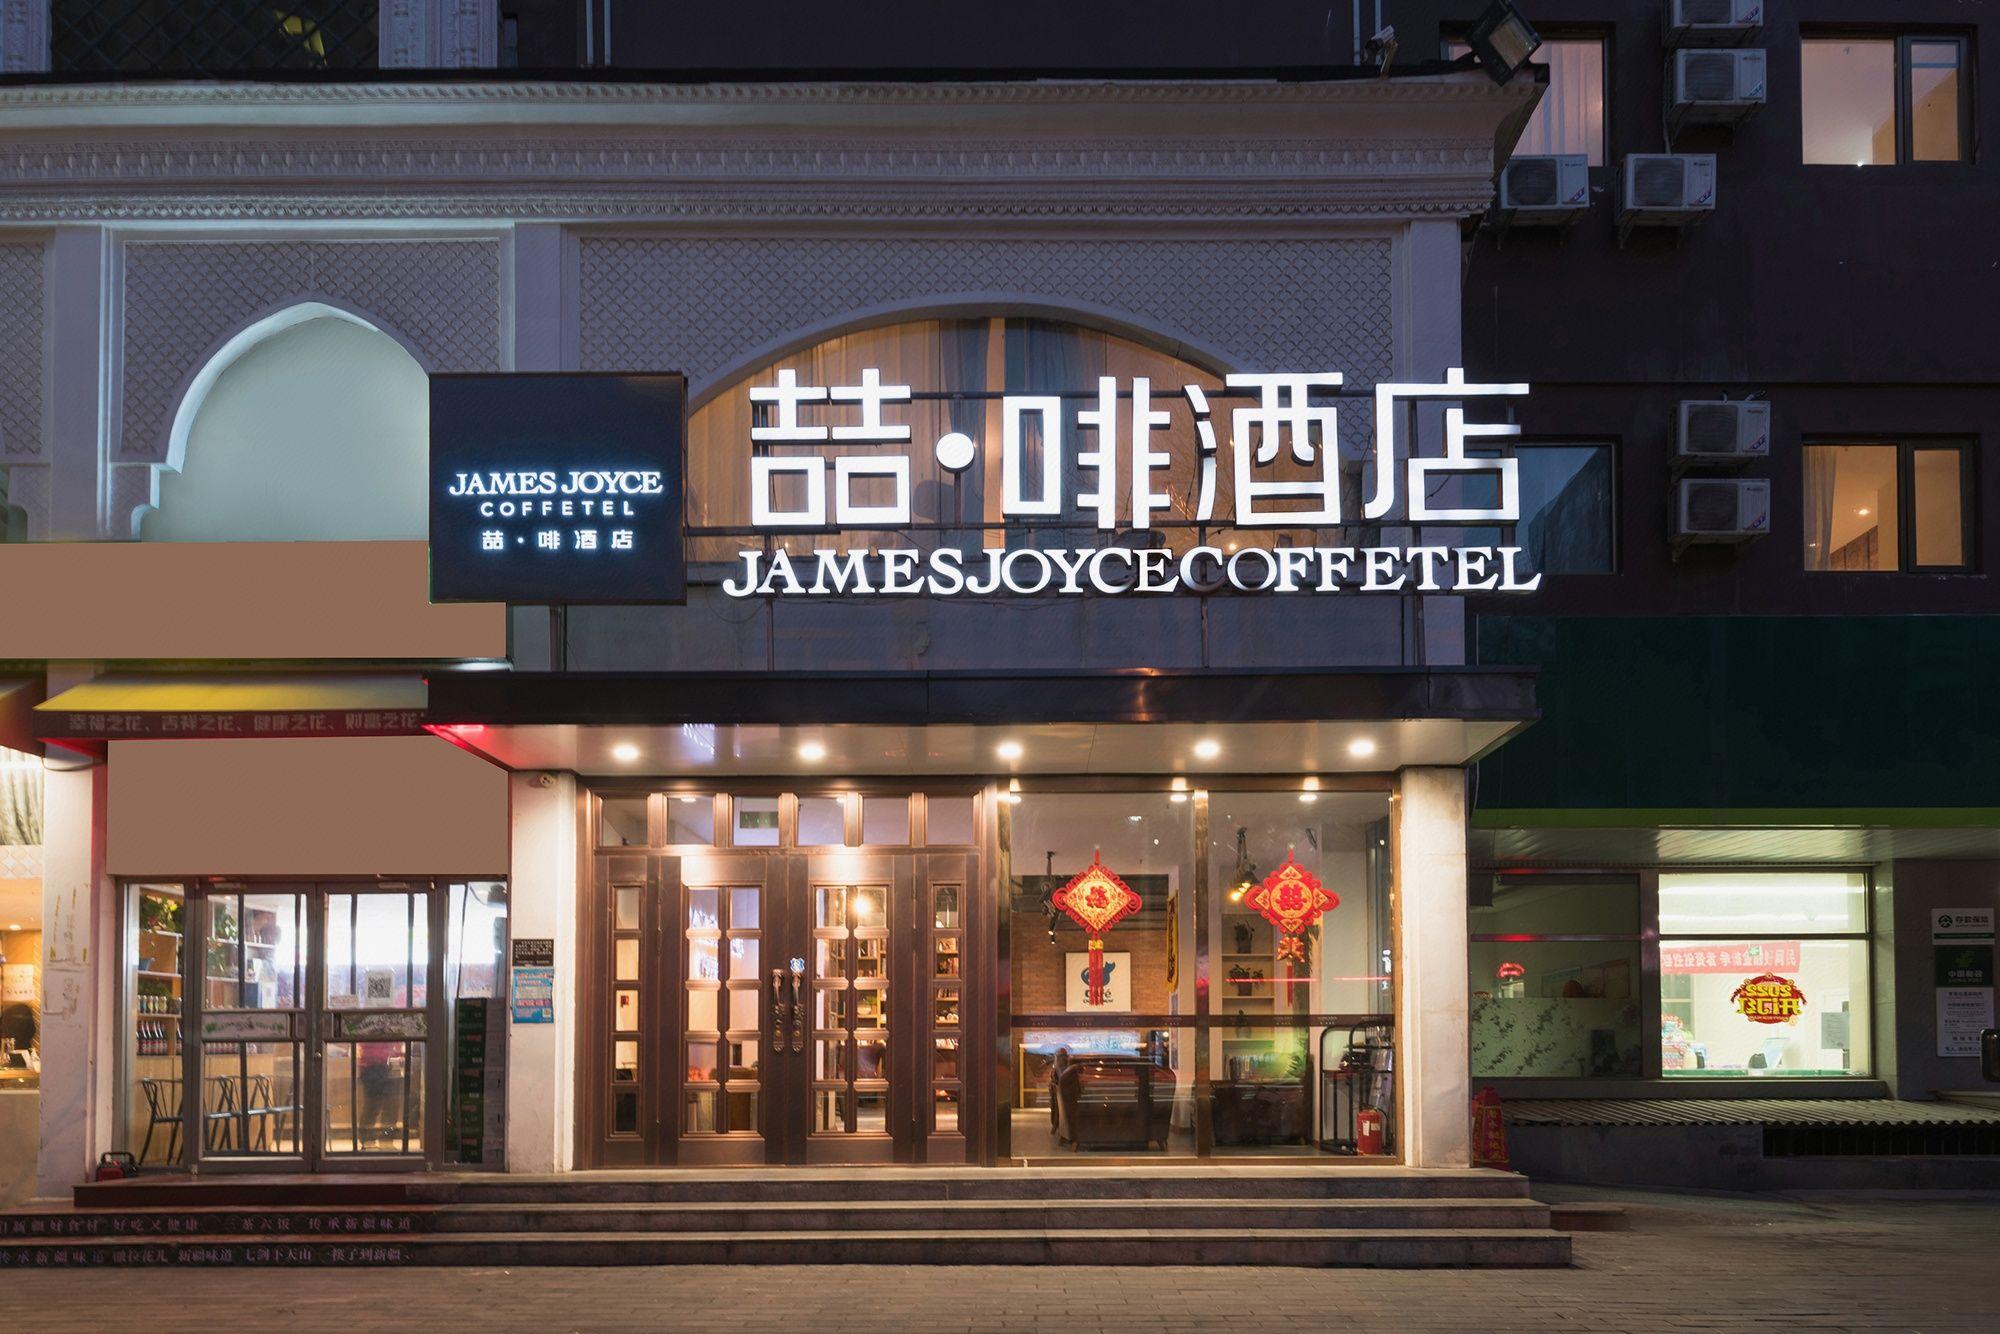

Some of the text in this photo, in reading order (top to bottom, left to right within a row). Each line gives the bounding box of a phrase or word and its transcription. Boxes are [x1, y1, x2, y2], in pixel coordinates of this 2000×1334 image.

[749, 367, 1530, 530] 喆·啡酒店
[449, 471, 664, 495] JAMES JOYCE
[480, 500, 635, 517] COFFETEL
[723, 548, 1542, 598] JAMESJOYCECOFFETEL
